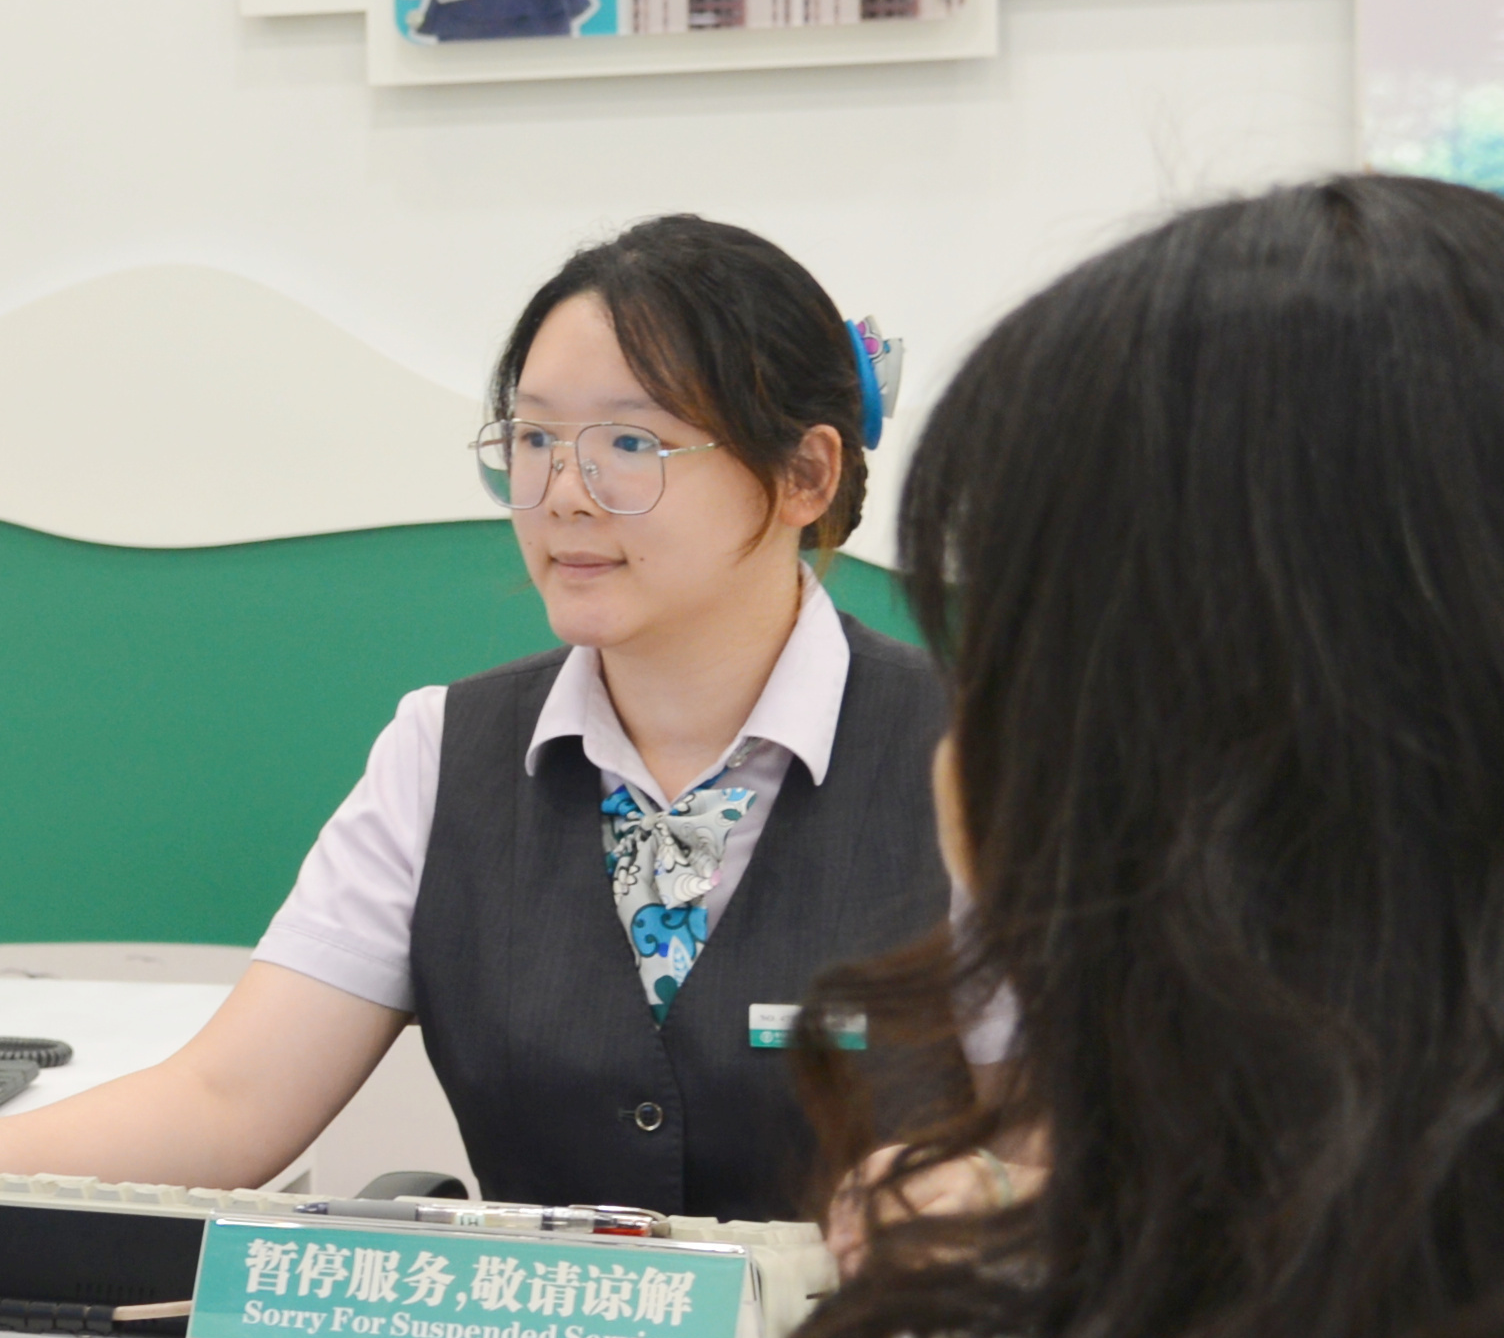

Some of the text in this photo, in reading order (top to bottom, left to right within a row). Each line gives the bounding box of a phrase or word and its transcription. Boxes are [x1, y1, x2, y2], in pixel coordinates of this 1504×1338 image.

[245, 1238, 695, 1327] 暂停服务,敬请谅解
[242, 1299, 323, 1335] Sorry
[330, 1307, 386, 1335] For
